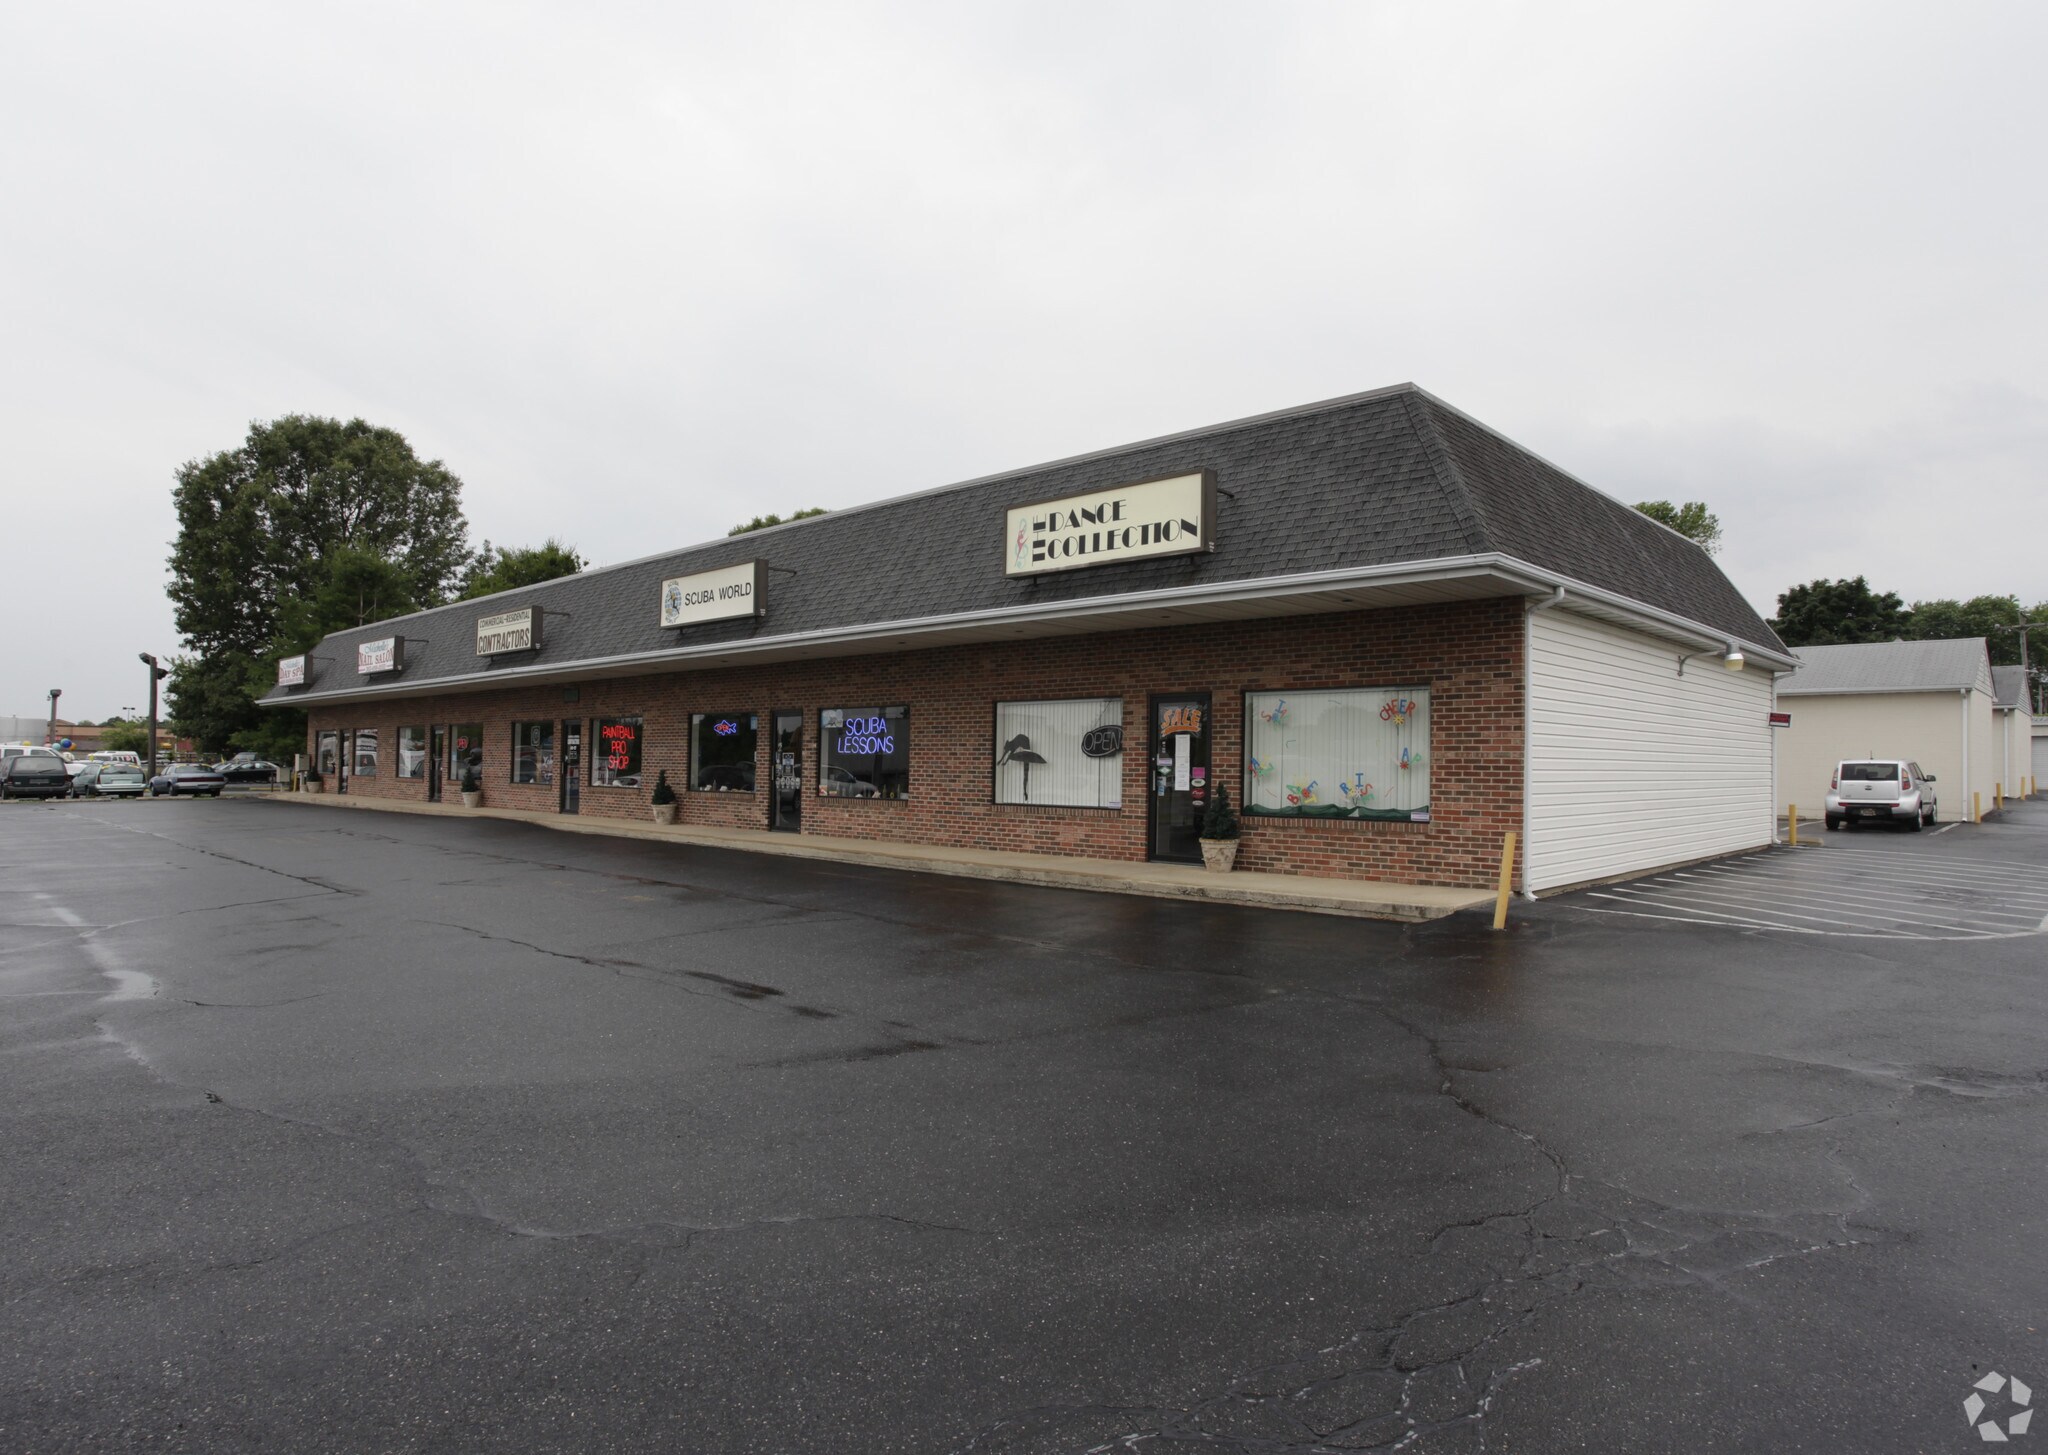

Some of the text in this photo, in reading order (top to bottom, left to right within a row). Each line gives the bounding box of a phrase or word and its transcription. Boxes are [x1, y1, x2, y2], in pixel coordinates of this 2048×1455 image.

[1049, 499, 1127, 532] DANCE
[1032, 513, 1047, 567] THE
[1047, 515, 1198, 559] COLLECTION
[684, 582, 752, 606] SCUBA WORLD
[478, 628, 530, 653] CONTRACTORS
[359, 647, 394, 666] NAIL SALON
[292, 664, 304, 678] SPA
[1160, 707, 1202, 730] SALE
[1380, 699, 1416, 721] CHEER
[602, 725, 635, 739] PAINTBALL
[845, 716, 887, 736] SCUBA
[611, 740, 627, 754] PRO
[837, 736, 894, 755] LESSONS
[1084, 731, 1121, 751] OPEN
[608, 754, 629, 770] SHOP
